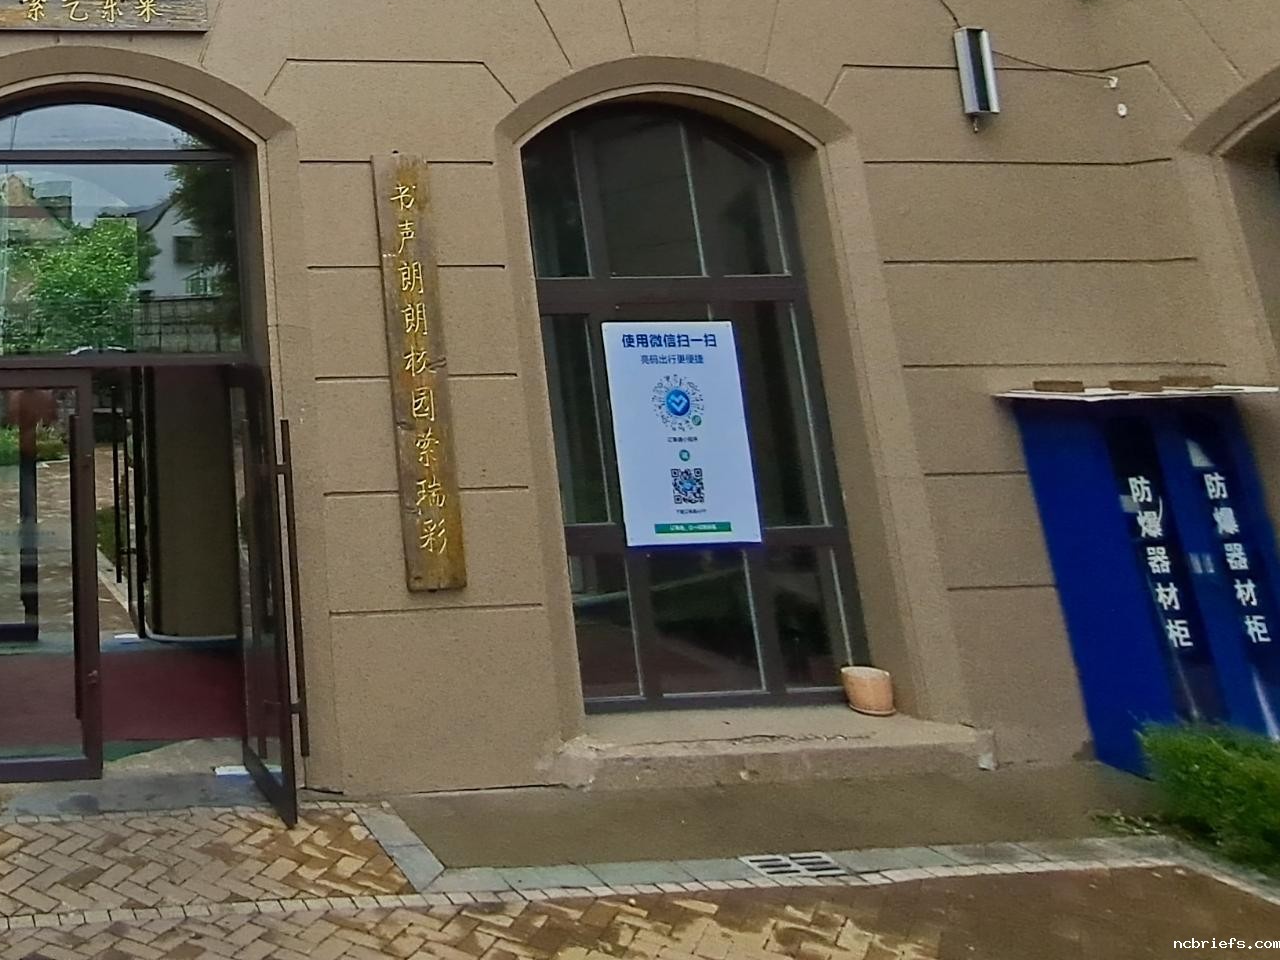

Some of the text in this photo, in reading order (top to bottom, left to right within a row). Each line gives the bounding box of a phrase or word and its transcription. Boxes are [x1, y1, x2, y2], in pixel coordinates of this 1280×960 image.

[621, 333, 718, 348] 使用微信扫一扫
[1127, 475, 1194, 648] 防爆器材柜
[1203, 471, 1272, 644] 防爆器材柜
